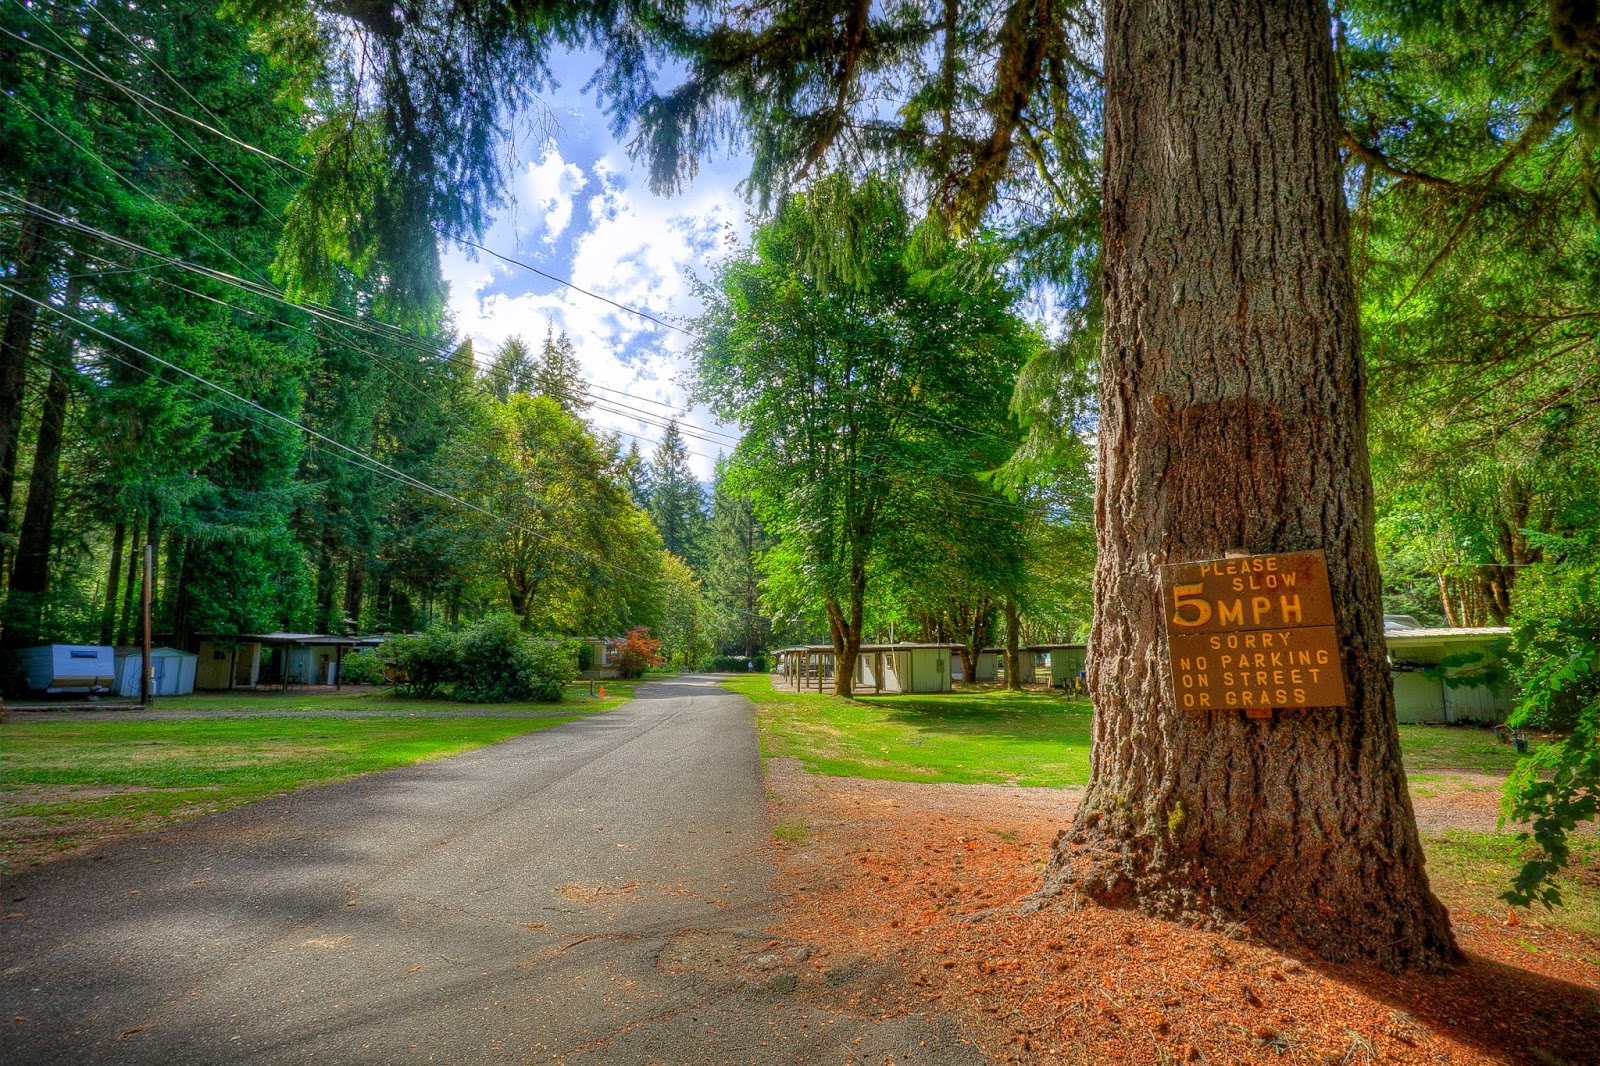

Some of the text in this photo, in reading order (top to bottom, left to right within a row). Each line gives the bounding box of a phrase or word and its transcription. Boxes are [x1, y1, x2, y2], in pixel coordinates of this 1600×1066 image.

[1201, 558, 1277, 577] PLEASE
[1233, 572, 1296, 591] SLOW
[1173, 583, 1302, 627] 5 MPH
[1210, 632, 1290, 649] SORRY
[1181, 650, 1328, 670] NO PARKING
[1182, 669, 1320, 688] ON STREET
[1184, 689, 1305, 707] OR GRASS
